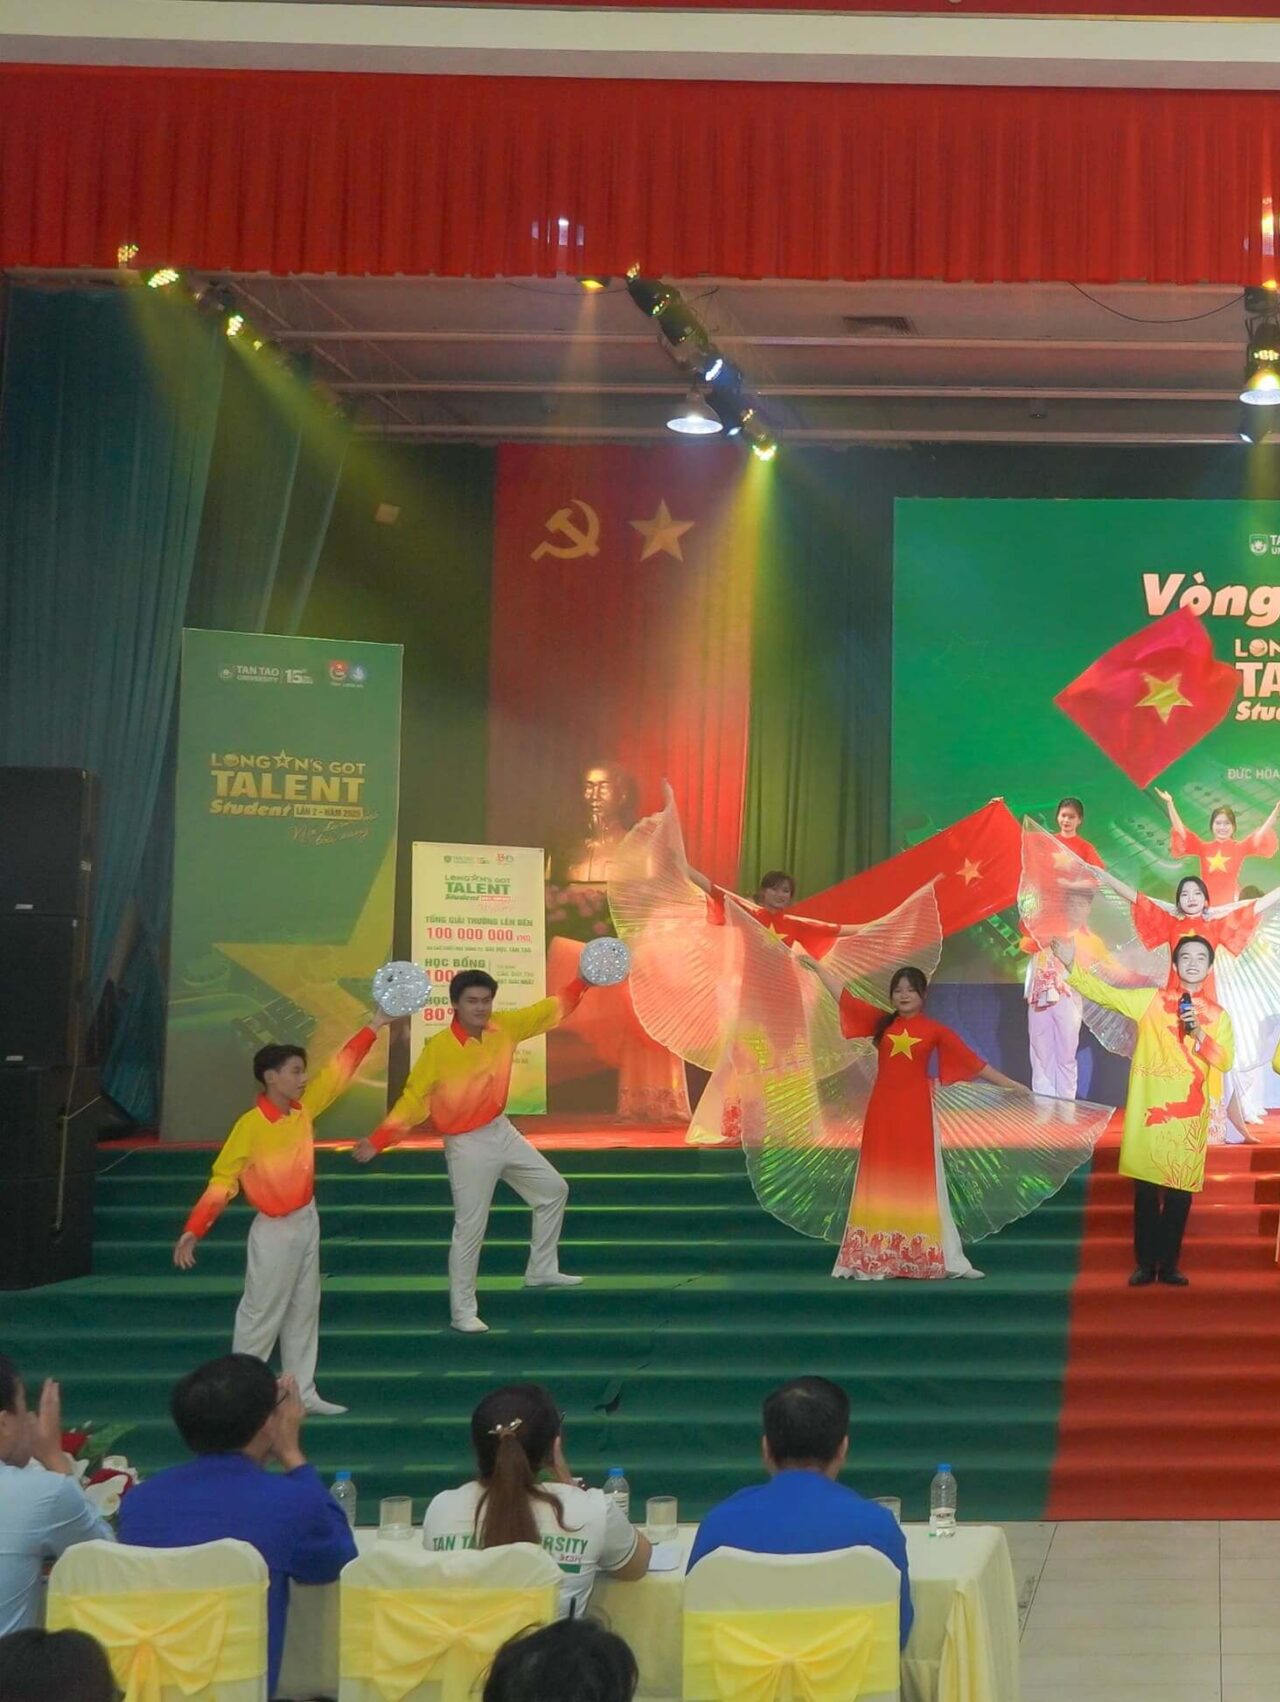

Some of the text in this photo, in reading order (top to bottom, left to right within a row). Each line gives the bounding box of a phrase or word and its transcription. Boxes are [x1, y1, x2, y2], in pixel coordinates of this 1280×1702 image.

[236, 665, 280, 677] TAN TAO
[328, 761, 367, 775] GOT
[1227, 766, 1252, 780] ĐỨC
[210, 769, 366, 804] TALENT
[209, 798, 293, 818] Student
[444, 882, 512, 895] TALENT
[426, 927, 452, 940] 100
[457, 927, 483, 940] 000
[487, 928, 514, 941] 000
[425, 957, 449, 968] HỌC
[453, 956, 486, 969] BỔNG
[432, 1535, 457, 1552] TAN
